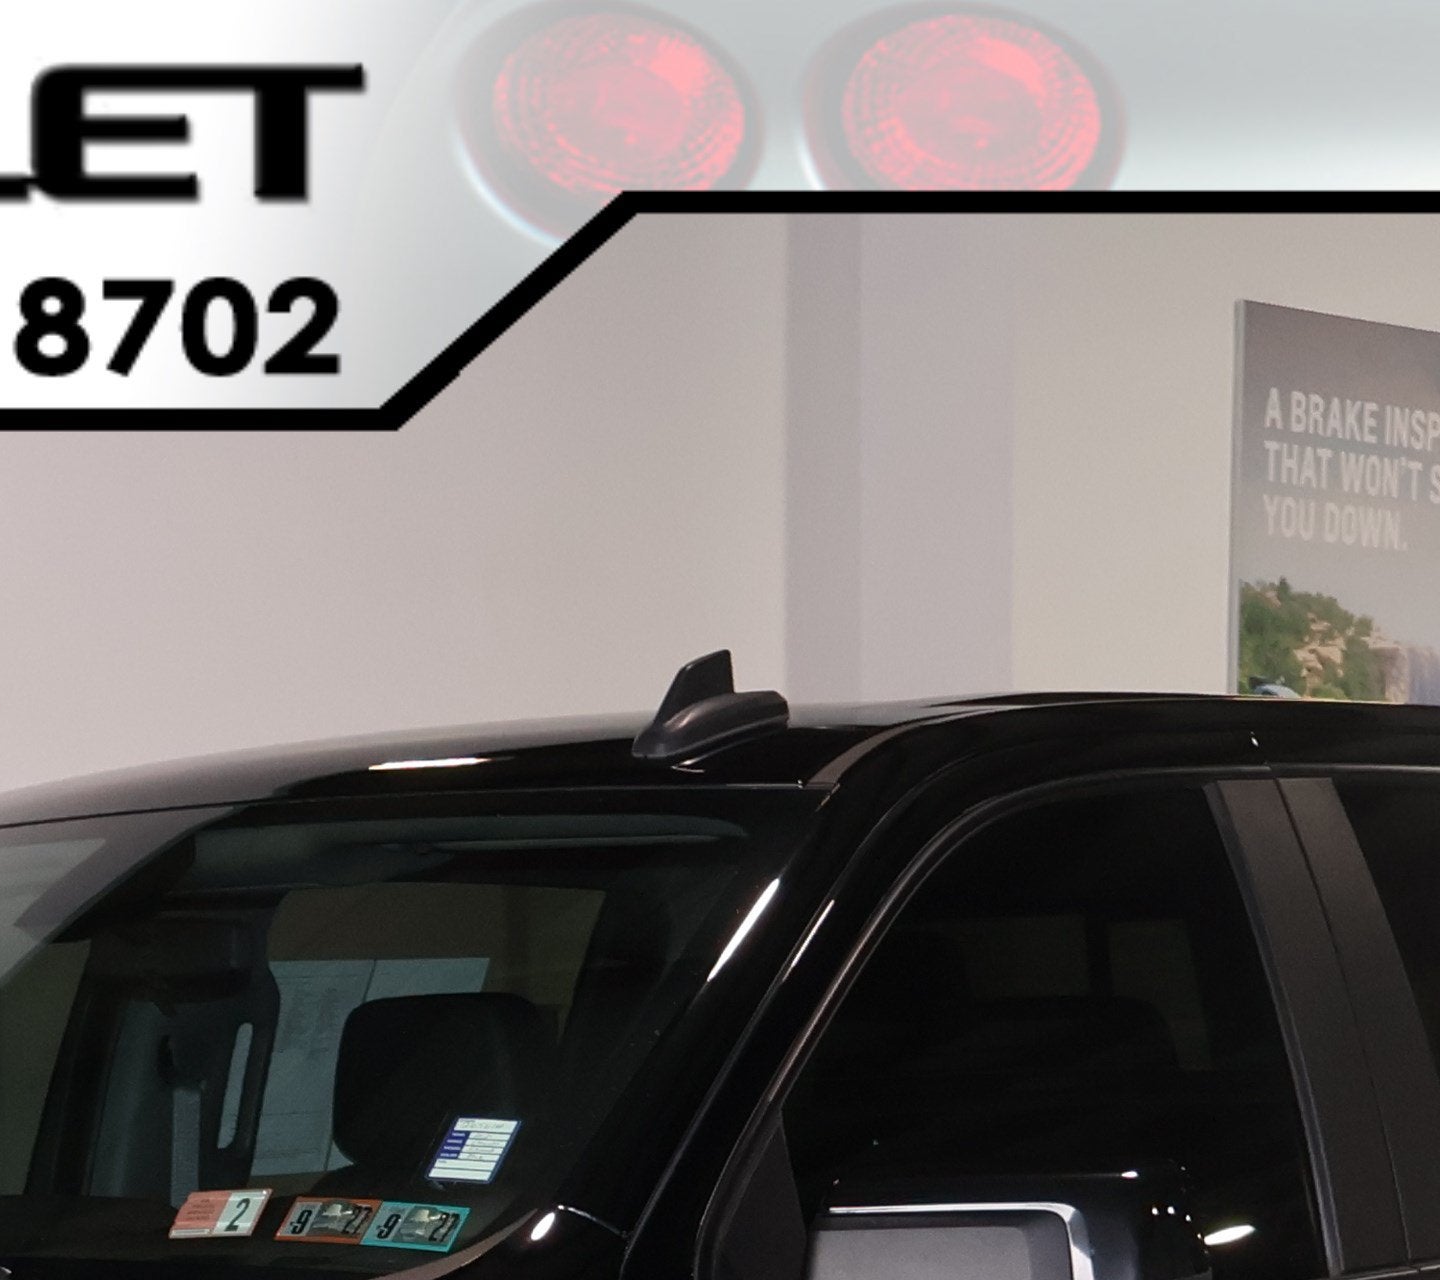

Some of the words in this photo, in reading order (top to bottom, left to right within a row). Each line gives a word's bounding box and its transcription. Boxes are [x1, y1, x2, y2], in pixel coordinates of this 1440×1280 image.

[1264, 387, 1281, 428] A
[1290, 391, 1378, 445] BRAKE
[1264, 441, 1333, 490] THAT
[1341, 452, 1424, 501] WON'T
[1262, 494, 1316, 541] YOU
[1324, 502, 1408, 551] DOWN.
[225, 1198, 251, 1232] 2
[342, 1205, 373, 1234] 27
[428, 1212, 460, 1242] 27
